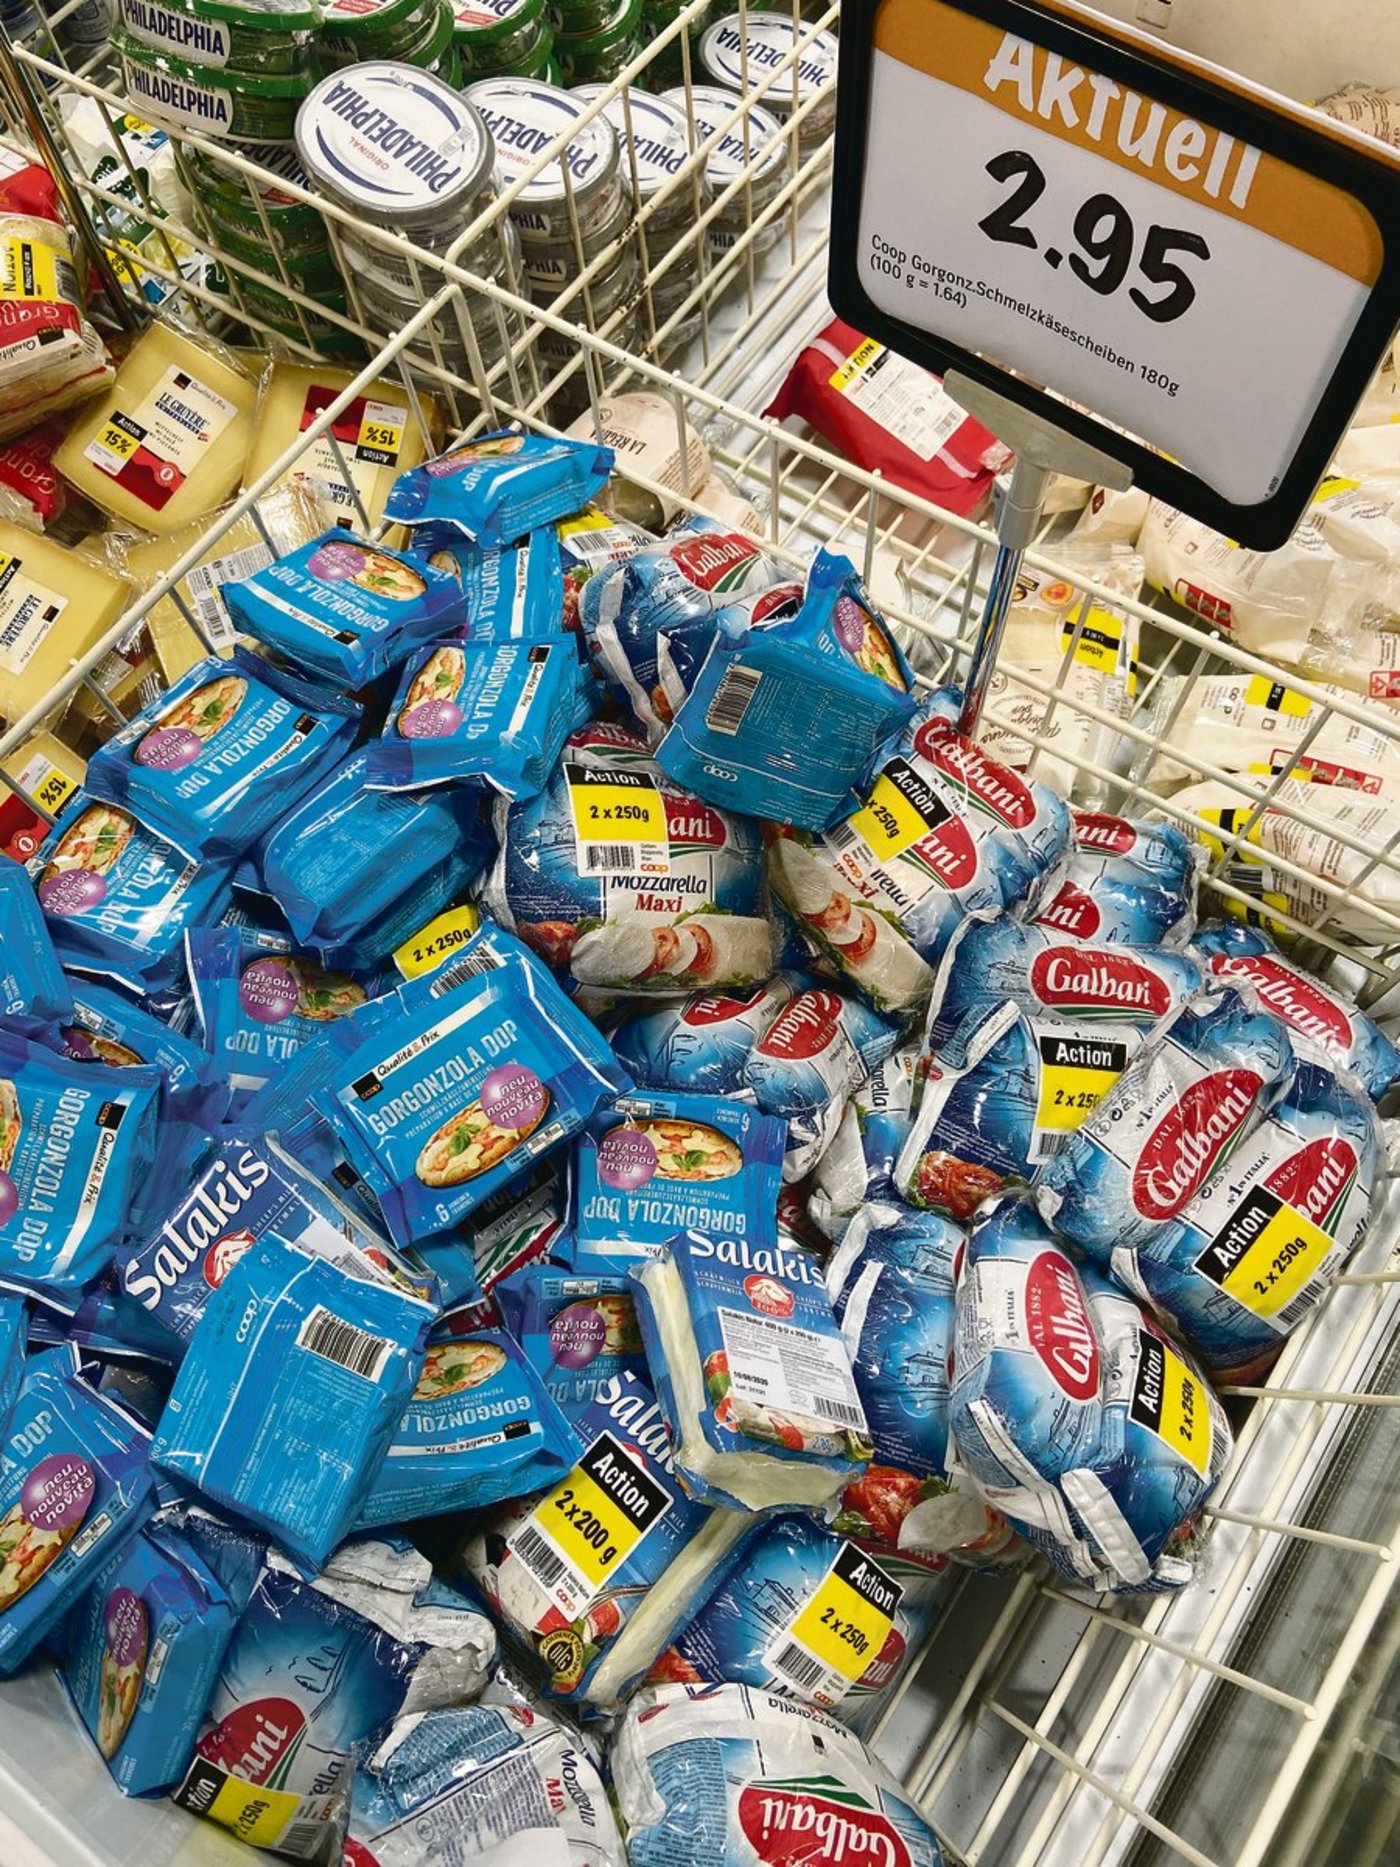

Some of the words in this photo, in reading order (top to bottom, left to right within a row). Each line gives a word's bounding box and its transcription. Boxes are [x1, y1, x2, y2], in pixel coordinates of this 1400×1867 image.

[124, 0, 226, 57] PHILADELPHIA
[322, 80, 461, 193] PHILADELPHIA
[983, 32, 1262, 209] Aktuell
[350, 136, 390, 171] ORIGINAL
[978, 150, 1211, 323] 2.95
[870, 255, 902, 280] (100
[906, 272, 915, 288] g
[919, 279, 929, 289] =
[932, 282, 968, 310] 1.64)
[872, 234, 907, 264] Coop
[1140, 364, 1181, 398] 180g
[159, 391, 174, 407] LE
[104, 430, 132, 454] 15%
[117, 416, 141, 437] Action
[365, 426, 396, 446] 15%
[268, 566, 302, 588] DOP
[294, 582, 391, 633] GORGONZOLA
[473, 645, 519, 720] ORGONZOLA
[203, 698, 294, 775] ORGONZOLA
[585, 769, 640, 786] Action
[702, 763, 739, 783] coop
[923, 722, 1026, 817] Galbani
[40, 777, 67, 806] 15%
[892, 767, 936, 815] Action
[590, 805, 600, 819] 2
[603, 808, 612, 819] x
[615, 806, 650, 822] 250g
[873, 805, 900, 839] 250g
[640, 863, 669, 874] coop
[842, 853, 863, 879] coop
[635, 893, 684, 913] Maxi
[413, 949, 424, 962] 2
[425, 945, 436, 957] x
[436, 928, 473, 952] 250g
[5, 1000, 25, 1016] 6
[249, 993, 277, 1008] neu
[1218, 957, 1341, 1050] Galbani
[766, 991, 831, 1054] Galbani
[225, 1028, 262, 1055] DOP
[376, 1048, 413, 1077] Qualité
[420, 1029, 441, 1049] Prix
[1055, 1041, 1113, 1067] Action
[167, 1064, 186, 1083] 6
[367, 1045, 487, 1137] GORGONZOLA
[480, 1019, 518, 1058] DOP
[498, 1075, 526, 1096] neu
[485, 1079, 540, 1118] nouveau
[1054, 1090, 1063, 1106] 2
[1066, 1096, 1077, 1107] x
[741, 1112, 751, 1132] 6
[27, 1086, 92, 1213] GORGONZOLA
[93, 1131, 115, 1175] Qualité
[598, 1152, 657, 1166] nouveau
[1145, 1080, 1252, 1209] Galbani
[605, 1162, 633, 1174] neu
[83, 1184, 100, 1205] Prix
[125, 1149, 270, 1311] Salakis
[435, 1205, 449, 1223] 6
[584, 1195, 621, 1223] DOP
[627, 1198, 748, 1235] GORGONZOLA
[12, 1216, 49, 1263] DOP
[1213, 1204, 1270, 1271] Action
[686, 1228, 827, 1291] Salakis
[1253, 1280, 1267, 1296] 2
[1266, 1272, 1279, 1286] x
[1273, 1236, 1309, 1275] 250g
[235, 1299, 259, 1344] coop
[551, 1331, 605, 1343] nouveau
[1046, 1264, 1094, 1384] Galbani
[558, 1342, 583, 1353] neu
[1137, 1347, 1164, 1414] Action
[400, 1395, 533, 1434] GORGONZOLA
[1184, 1412, 1195, 1428] x
[10, 1409, 54, 1459] DOP
[458, 1434, 502, 1451] Qualité
[1180, 1426, 1192, 1441] 2
[28, 1464, 88, 1524] nouveau
[43, 1463, 74, 1493] neu
[592, 1451, 651, 1519] Action
[598, 1545, 618, 1566] g
[555, 1587, 577, 1613] coop
[849, 1561, 895, 1612] Action
[820, 1607, 835, 1625] 2
[830, 1620, 844, 1634] x
[840, 1624, 870, 1657] 250g
[813, 1690, 835, 1706] coop
